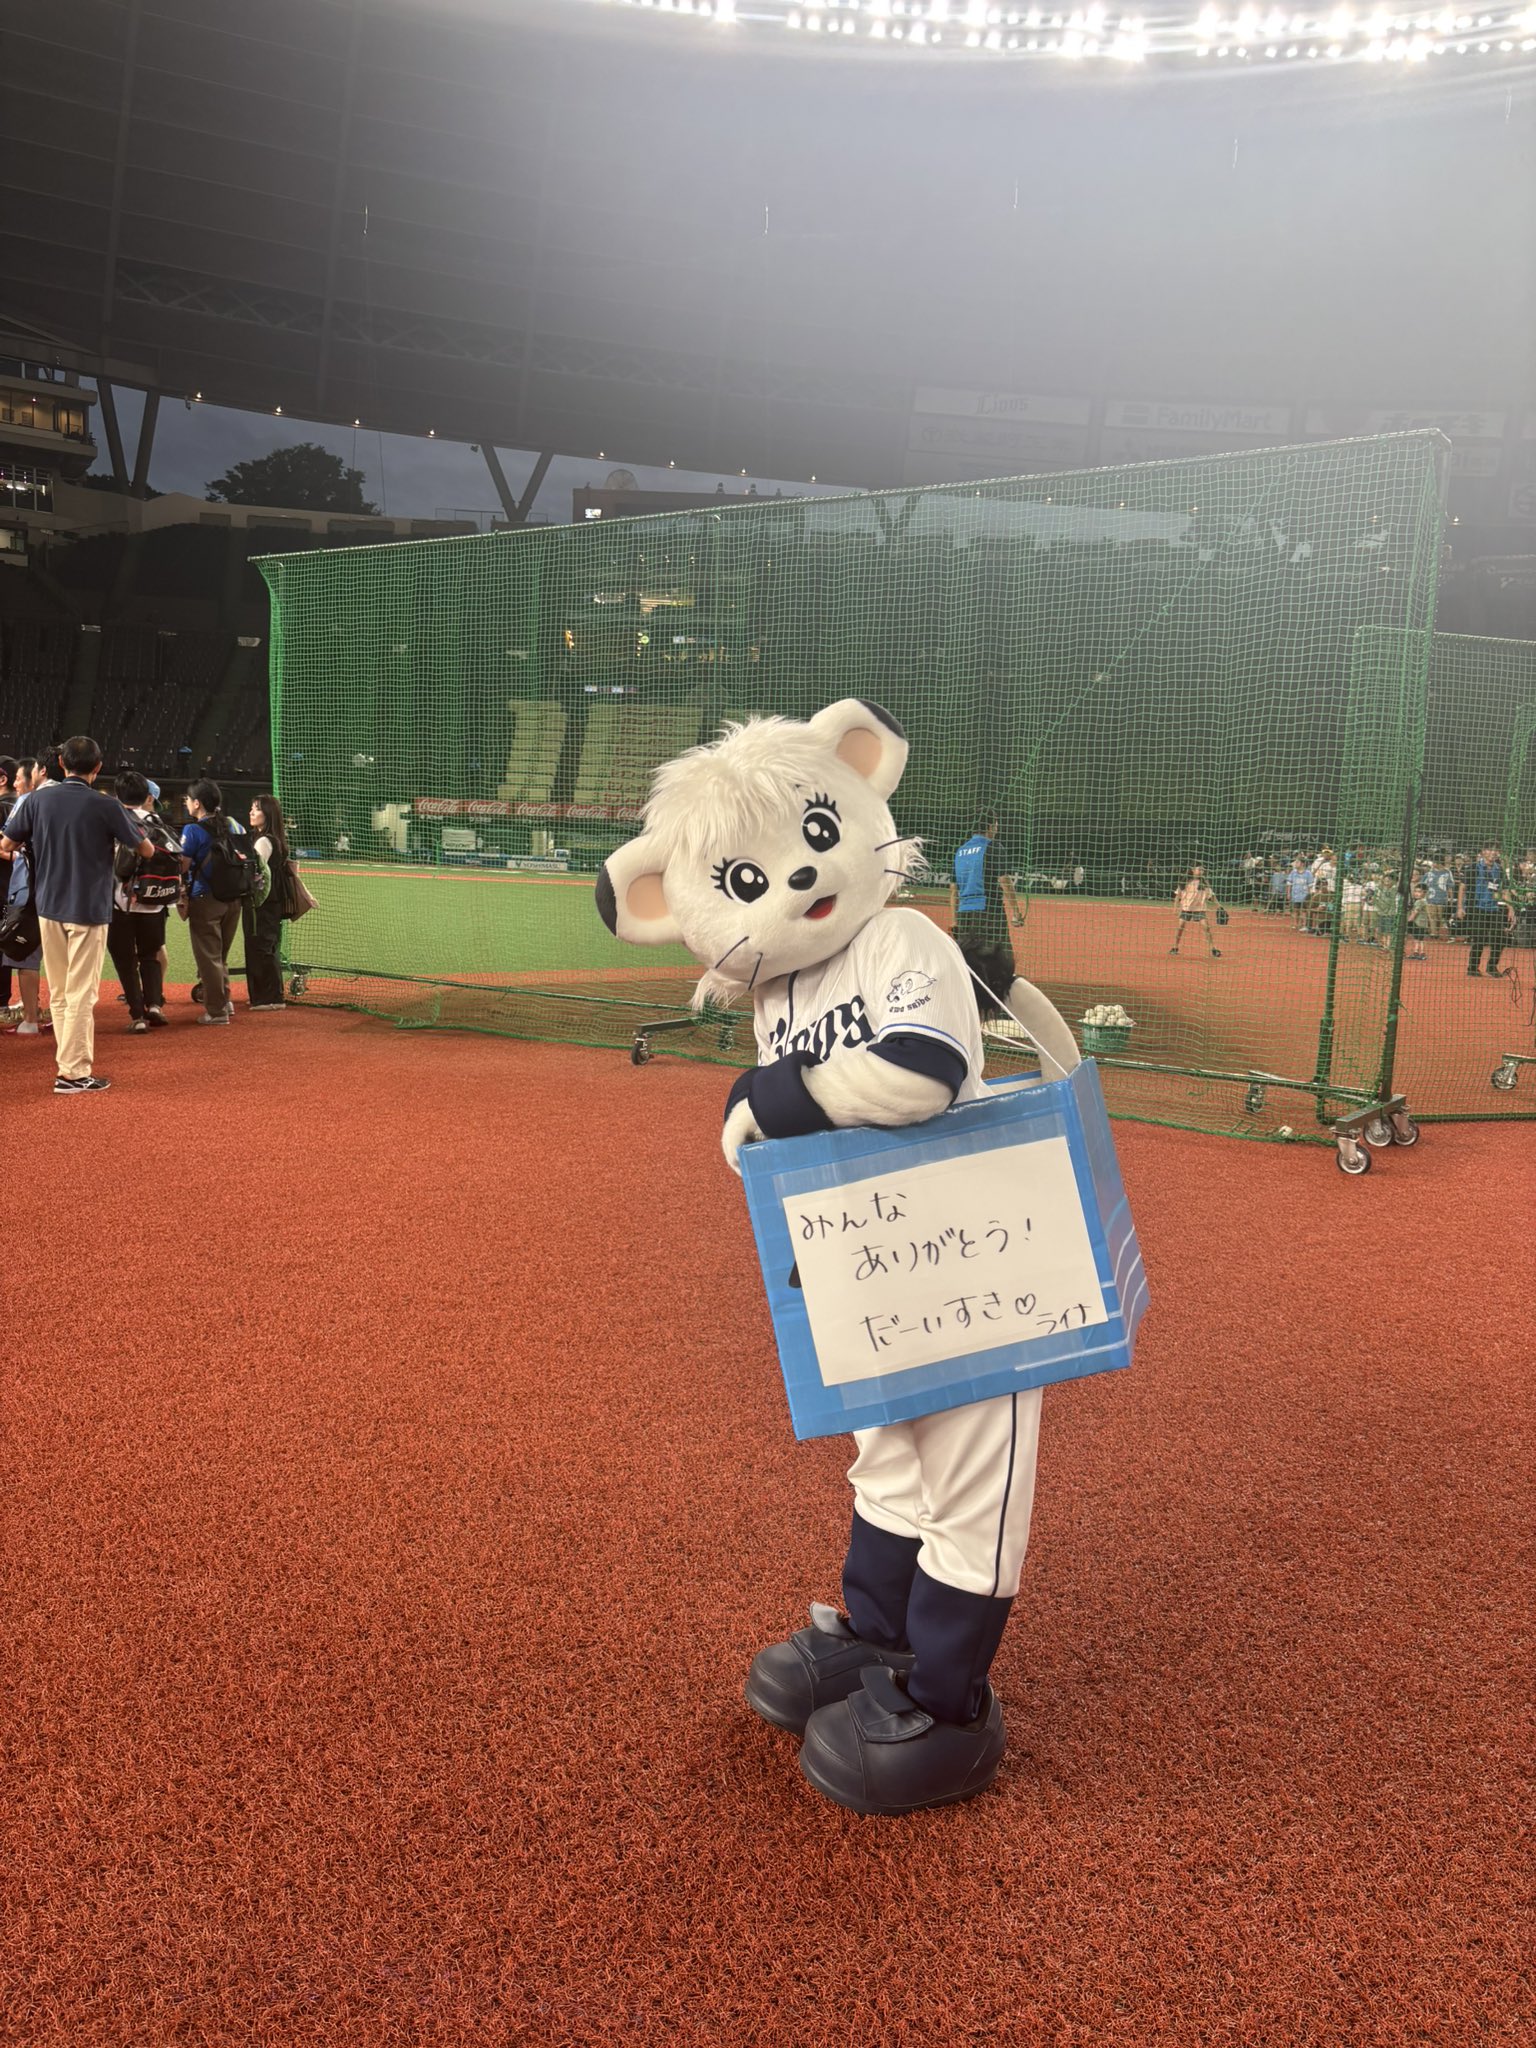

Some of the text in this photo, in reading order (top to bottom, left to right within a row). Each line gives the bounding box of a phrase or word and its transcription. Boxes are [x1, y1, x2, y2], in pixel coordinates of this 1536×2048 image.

[1154, 405, 1273, 431] FamilyMart
[957, 846, 982, 857] STAFF
[799, 1191, 908, 1241] みんな
[859, 1291, 1093, 1352] だーいすき ライナ
